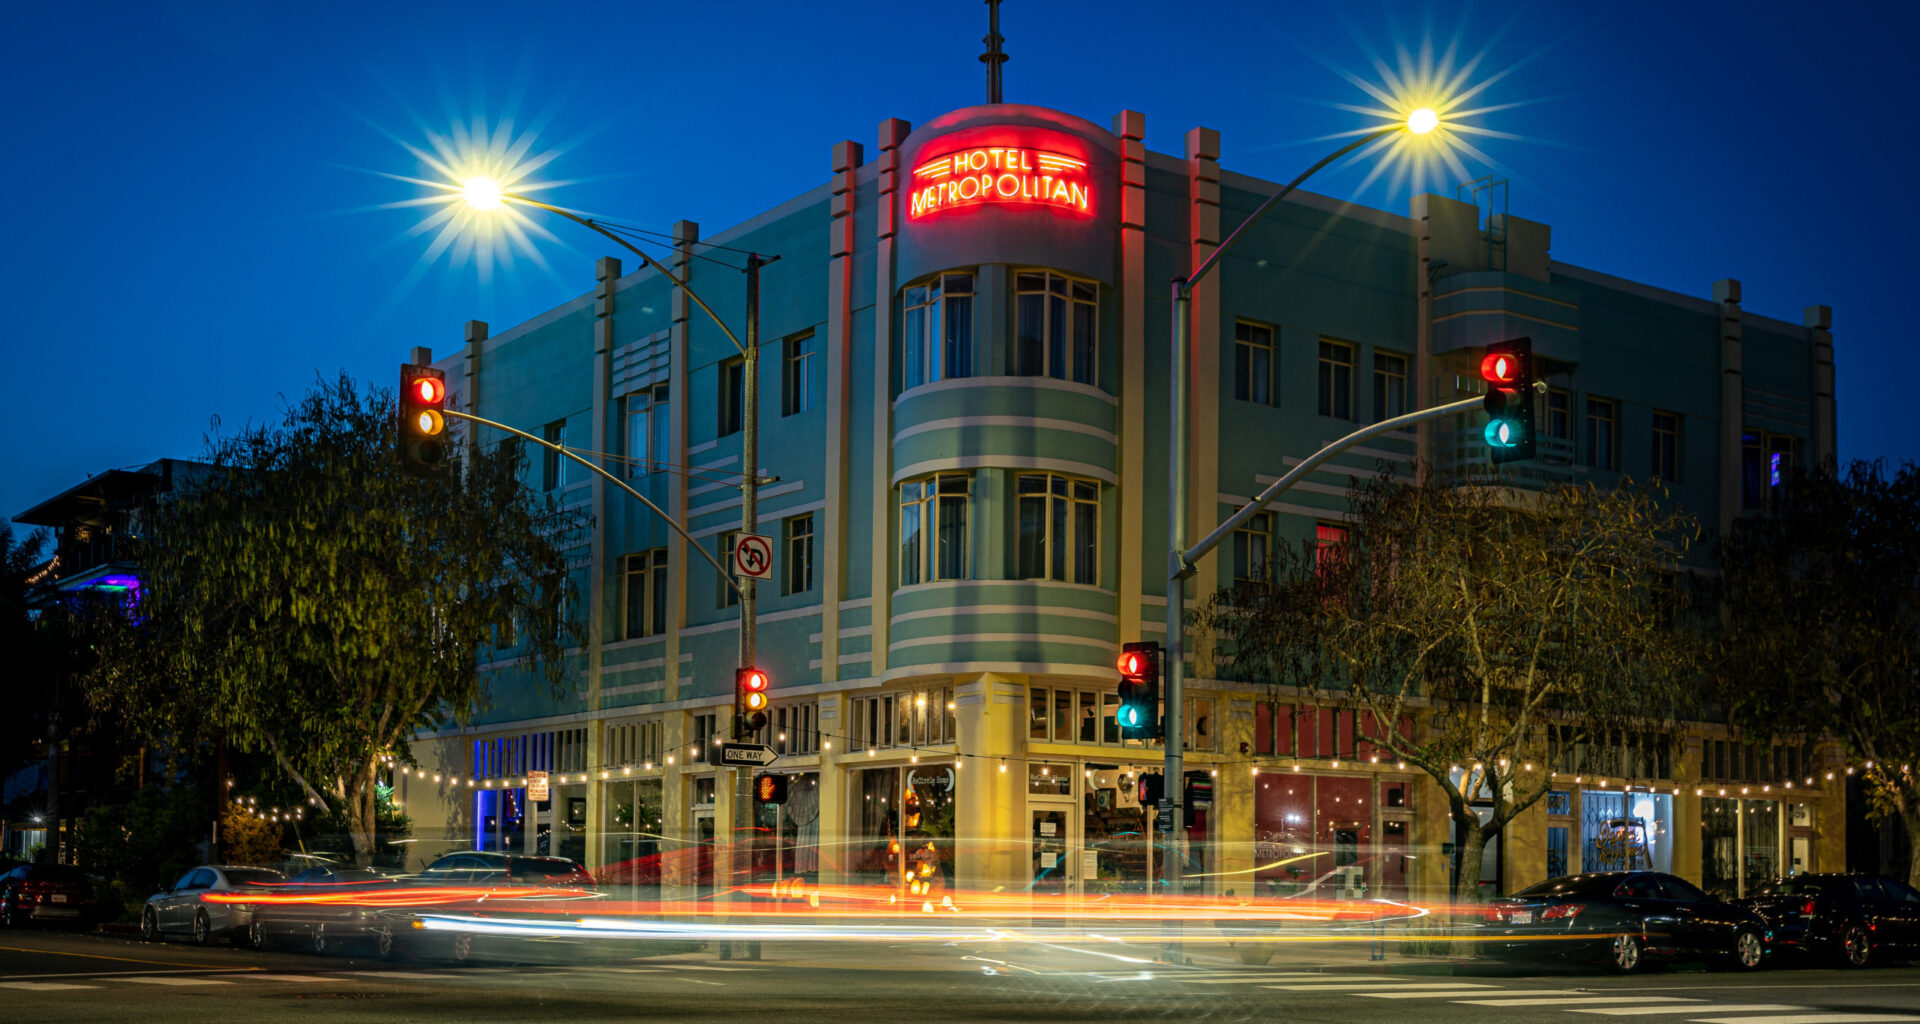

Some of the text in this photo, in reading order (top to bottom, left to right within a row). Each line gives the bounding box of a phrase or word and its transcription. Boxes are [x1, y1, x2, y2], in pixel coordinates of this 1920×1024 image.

[954, 150, 1033, 174] HOTEL
[911, 174, 1088, 215] METROPOLITAN
[727, 750, 763, 760] ONE WAY
